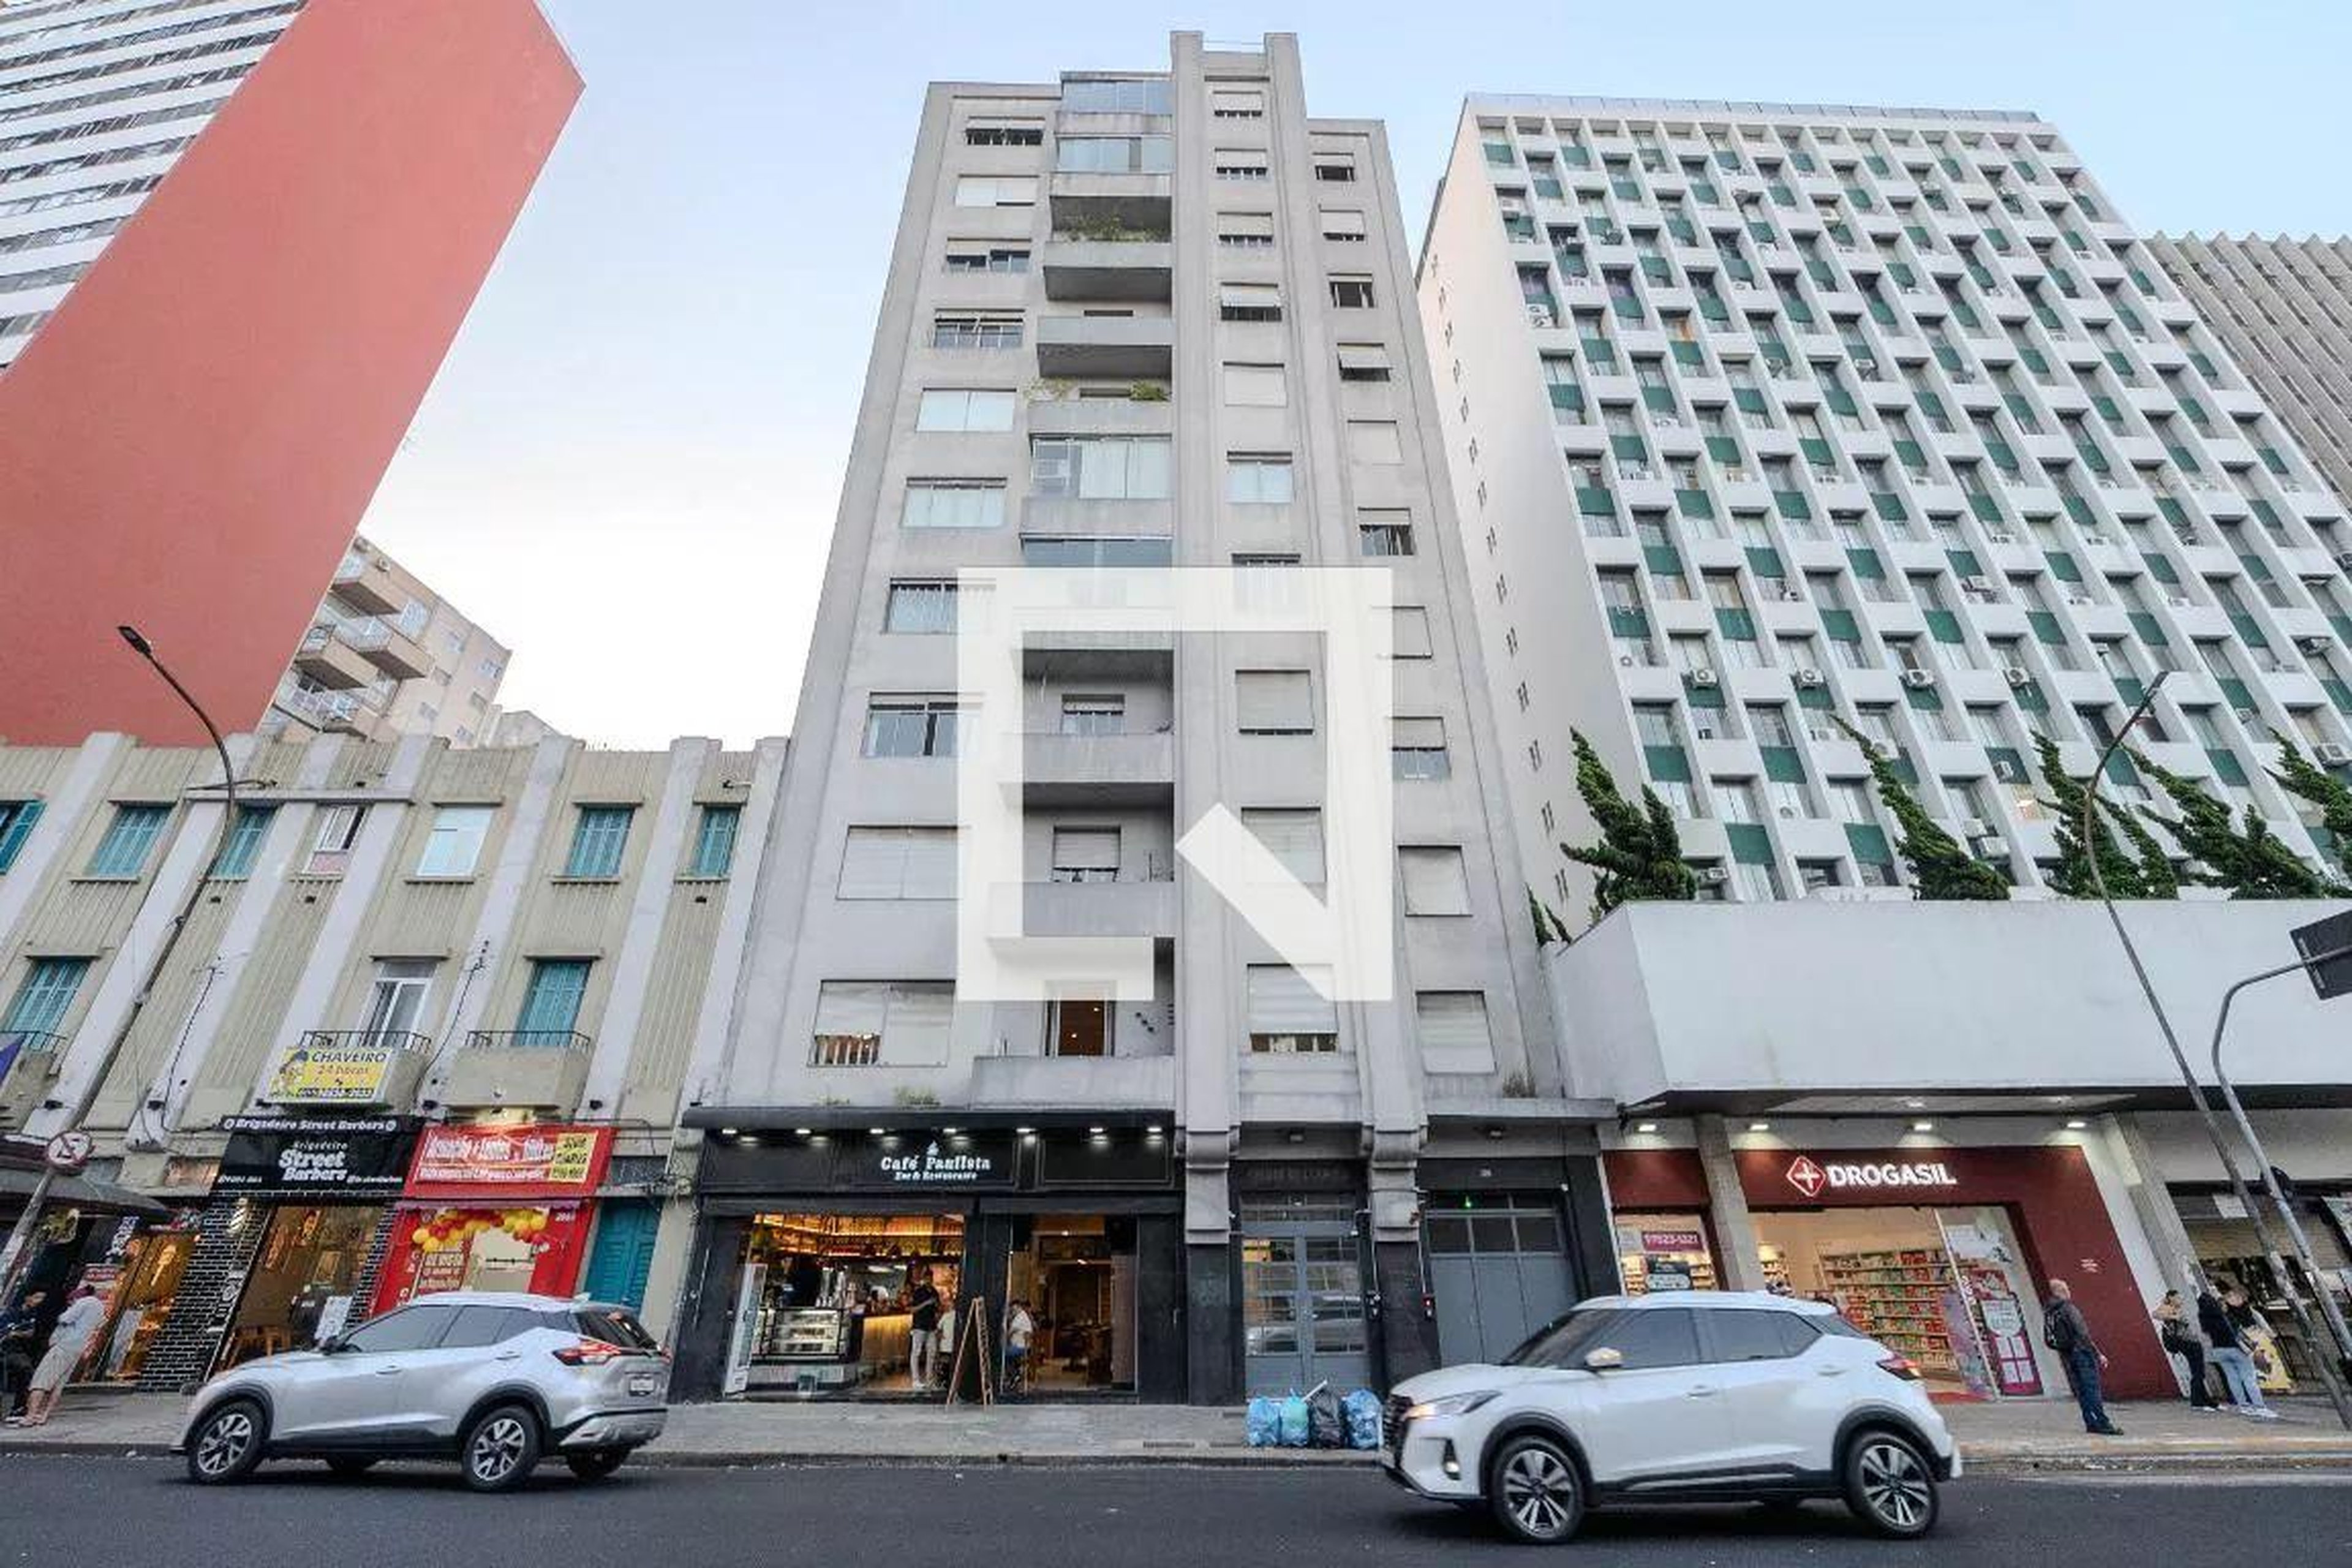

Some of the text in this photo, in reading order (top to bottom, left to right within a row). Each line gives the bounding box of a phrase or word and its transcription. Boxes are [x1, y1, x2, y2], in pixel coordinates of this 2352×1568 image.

[312, 1051, 386, 1063] CHAVEIRO
[235, 1118, 385, 1131] Brigadeiro Street Barbers
[279, 1148, 347, 1168] Street
[880, 1155, 991, 1171] Café Paulista
[282, 1167, 348, 1182] Barbers
[1825, 1163, 1958, 1188] DROGASIL
